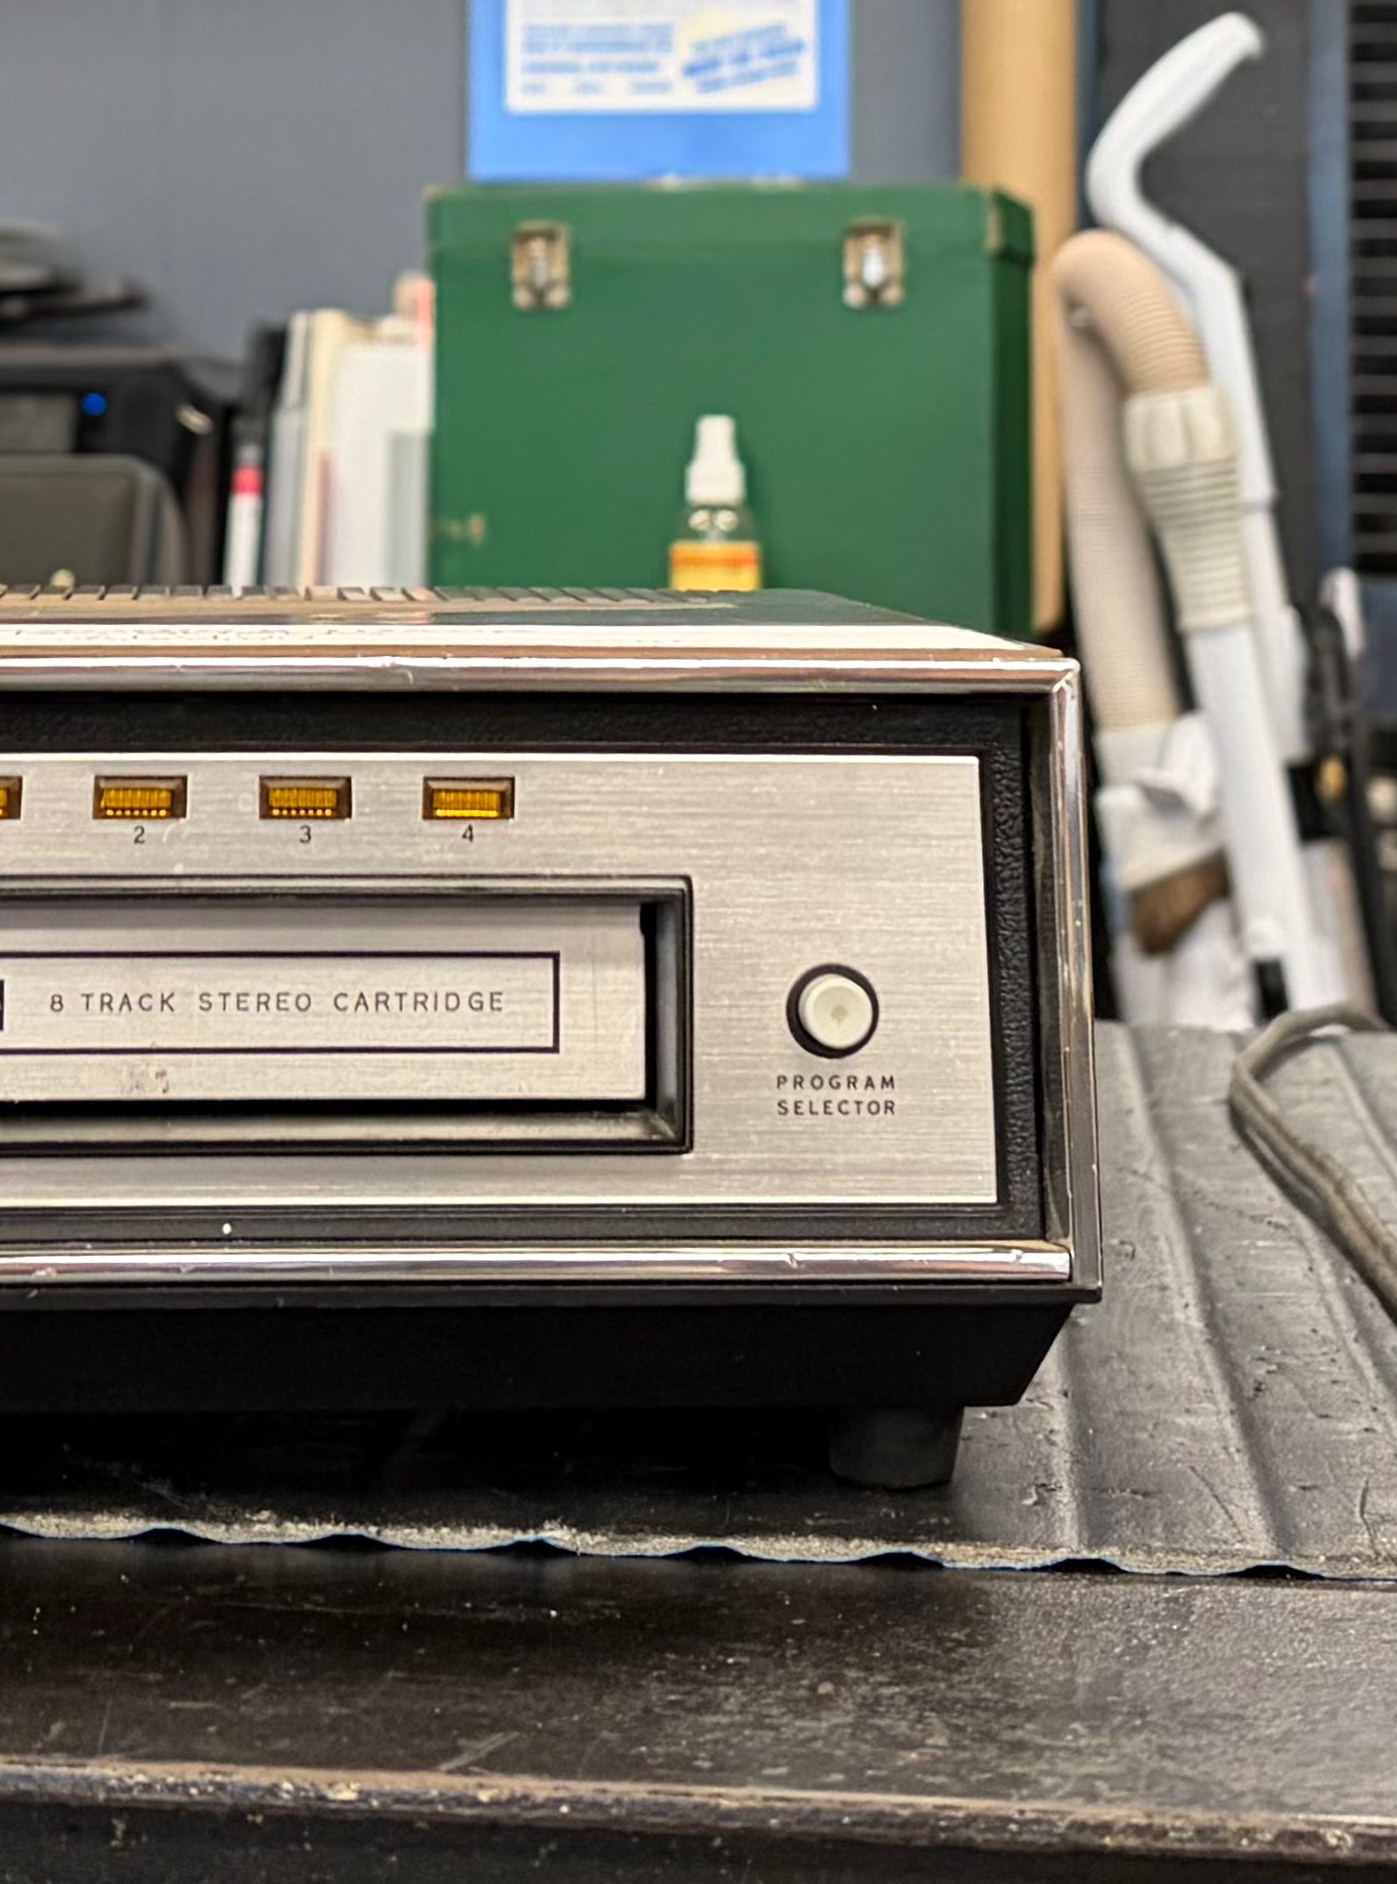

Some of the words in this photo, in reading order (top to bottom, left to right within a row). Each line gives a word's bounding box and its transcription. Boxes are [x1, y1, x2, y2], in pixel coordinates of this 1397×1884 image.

[133, 825, 146, 845] 2
[299, 825, 312, 844] 3
[461, 824, 475, 843] 4
[49, 992, 66, 1014] 8
[80, 992, 176, 1014] TRACK
[198, 991, 312, 1014] STEREO
[333, 991, 504, 1013] CARTRIDGE
[776, 1073, 896, 1091] PROGRAM
[776, 1098, 896, 1116] SELECTOR
